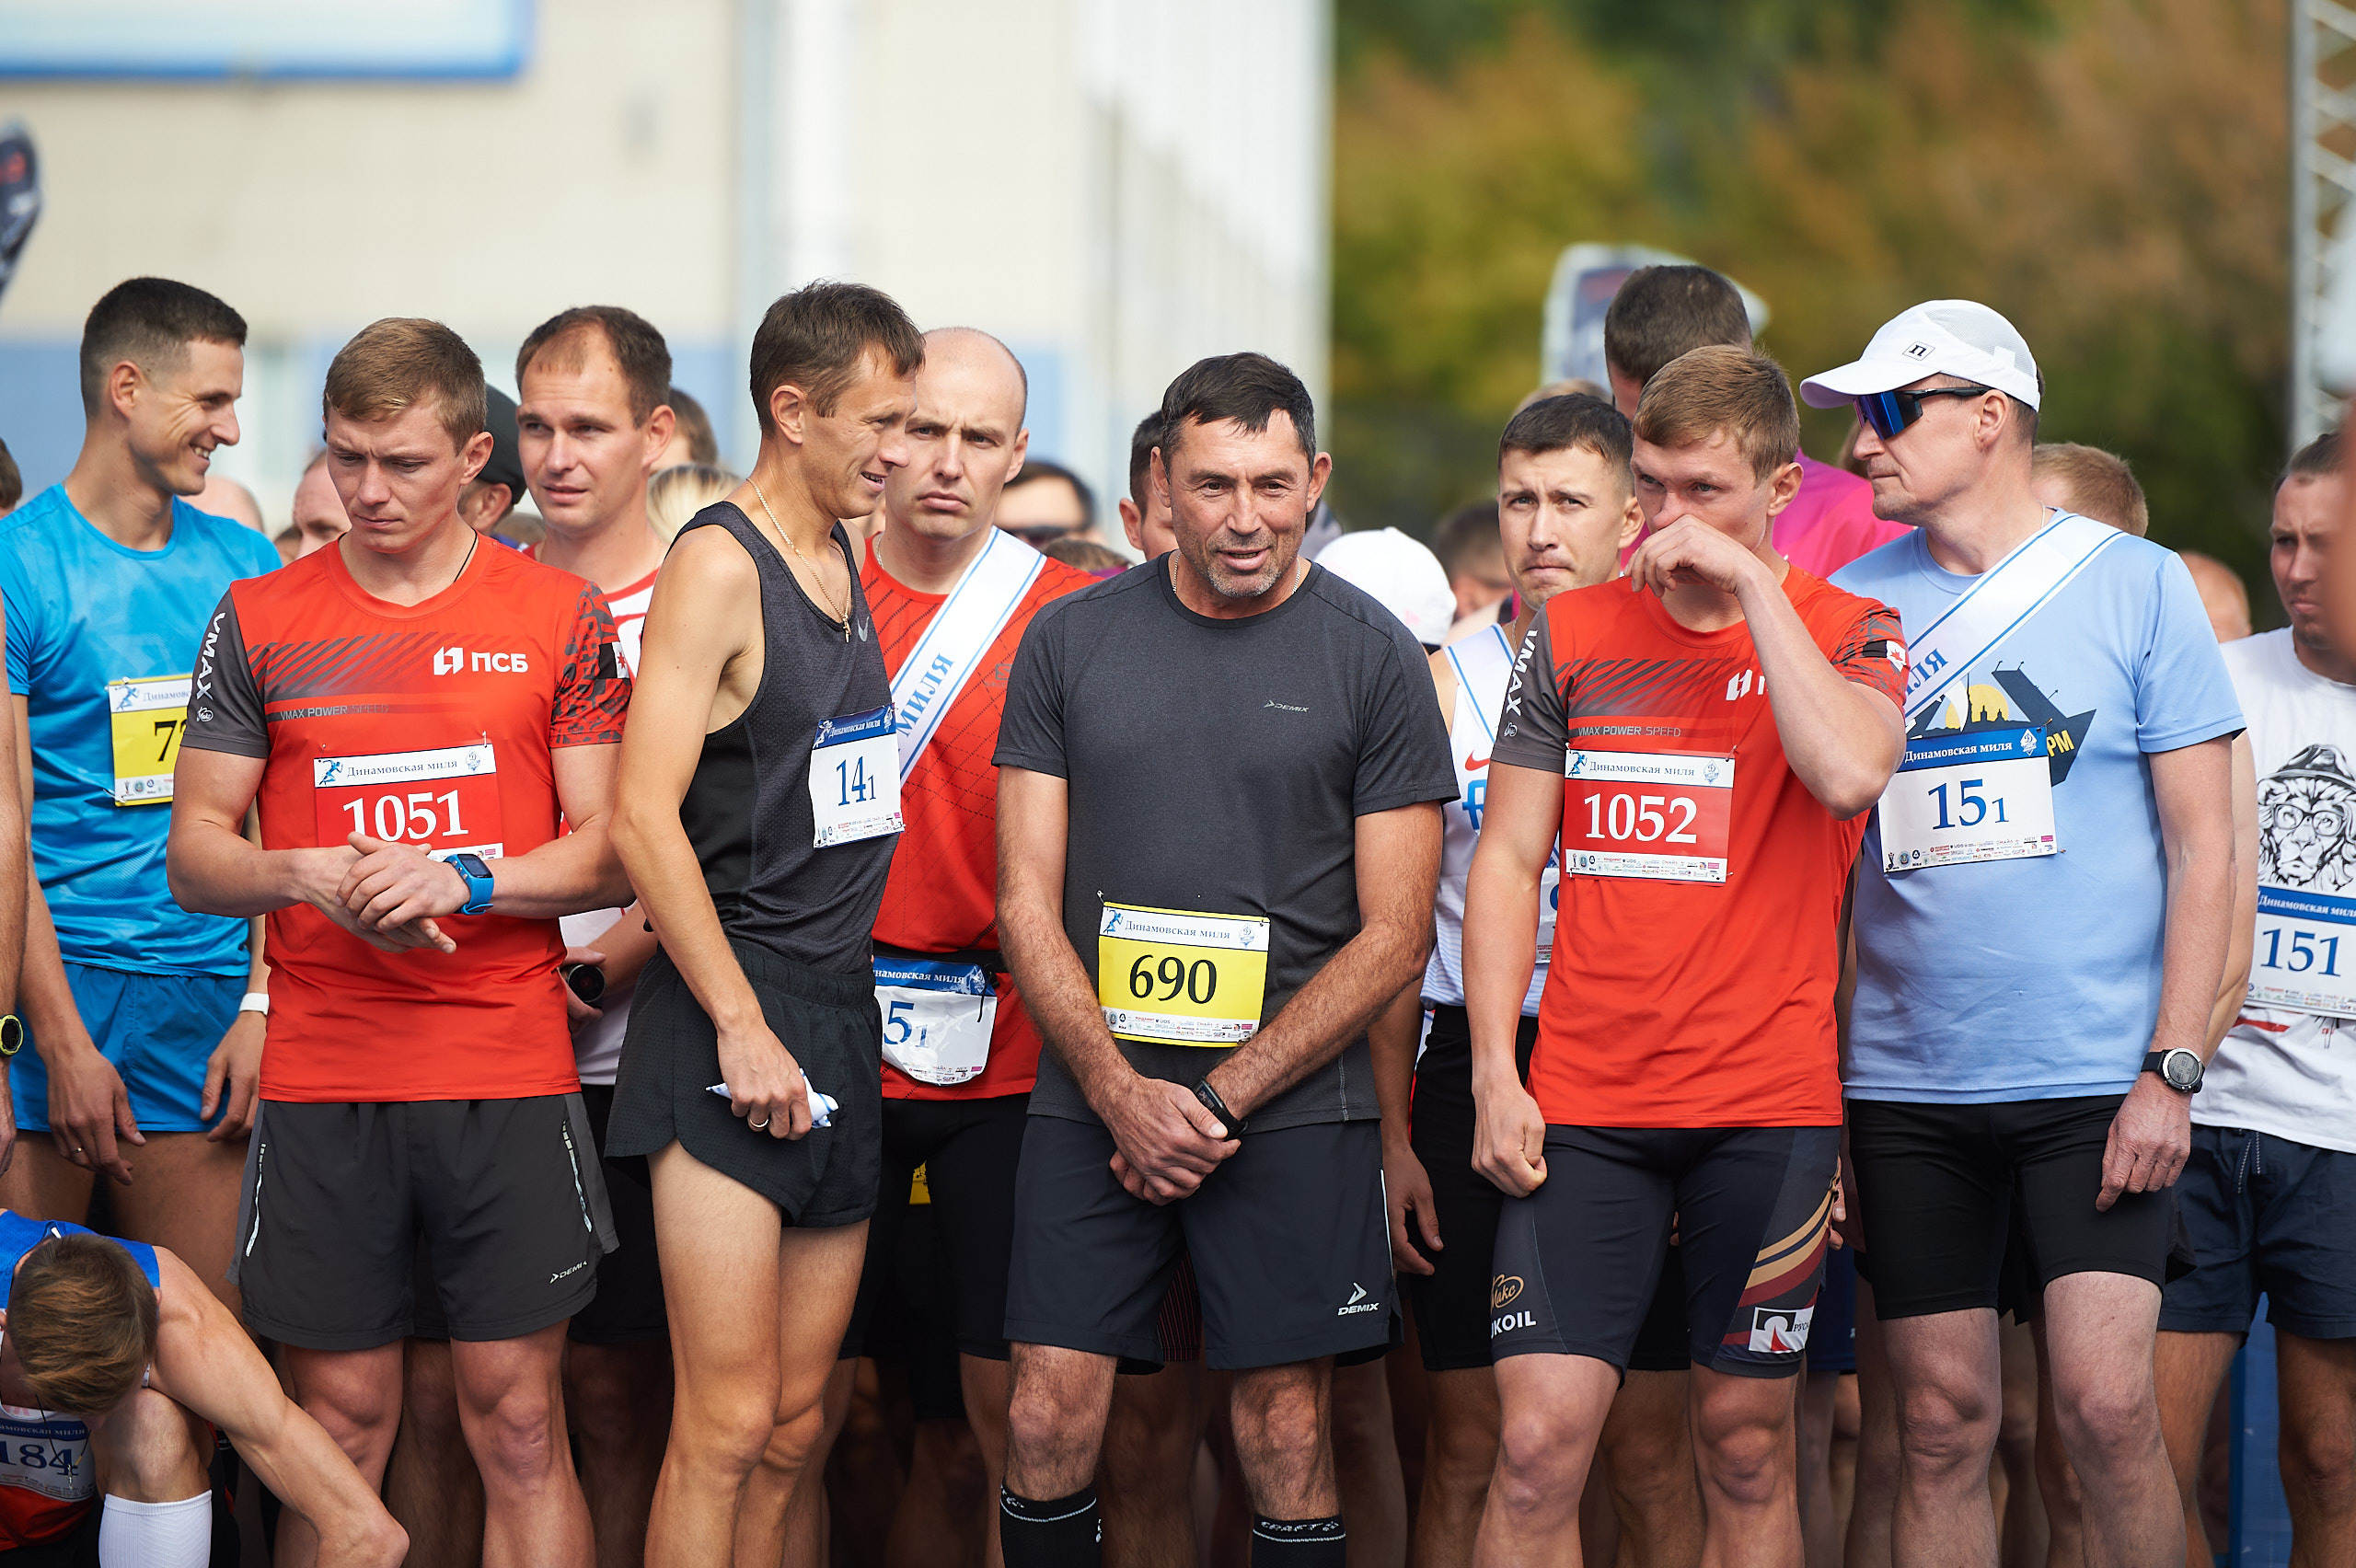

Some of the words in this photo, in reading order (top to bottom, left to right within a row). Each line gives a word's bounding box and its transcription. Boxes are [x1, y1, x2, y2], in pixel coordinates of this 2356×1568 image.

[196, 612, 225, 700] VMAX
[471, 651, 529, 673] ПСБ
[1506, 629, 1538, 717] VMAX
[280, 708, 305, 721] VMAX
[307, 705, 348, 717] POWER
[352, 704, 389, 714] SPEED
[154, 720, 187, 762] 7
[1578, 726, 1600, 736] VMAX
[1602, 725, 1642, 735] POWER
[1646, 726, 1681, 737] SPEED
[1905, 745, 1977, 763] Динамовская
[1980, 742, 2013, 753] миля
[347, 763, 423, 778] Динамовская
[427, 760, 457, 770] миля
[1589, 761, 1661, 775] Динамовская
[1664, 767, 1695, 777] миля
[342, 789, 469, 842] 1051
[1584, 793, 1697, 844] 1052
[2258, 894, 2329, 915] Динамовская
[1125, 920, 1196, 937] Динамовская
[1199, 930, 1230, 940] миля
[2260, 928, 2341, 976] 151
[872, 969, 931, 981] намовская
[934, 974, 964, 984] миля
[1129, 954, 1218, 1004] 690
[1337, 1302, 1380, 1316] DEMIX
